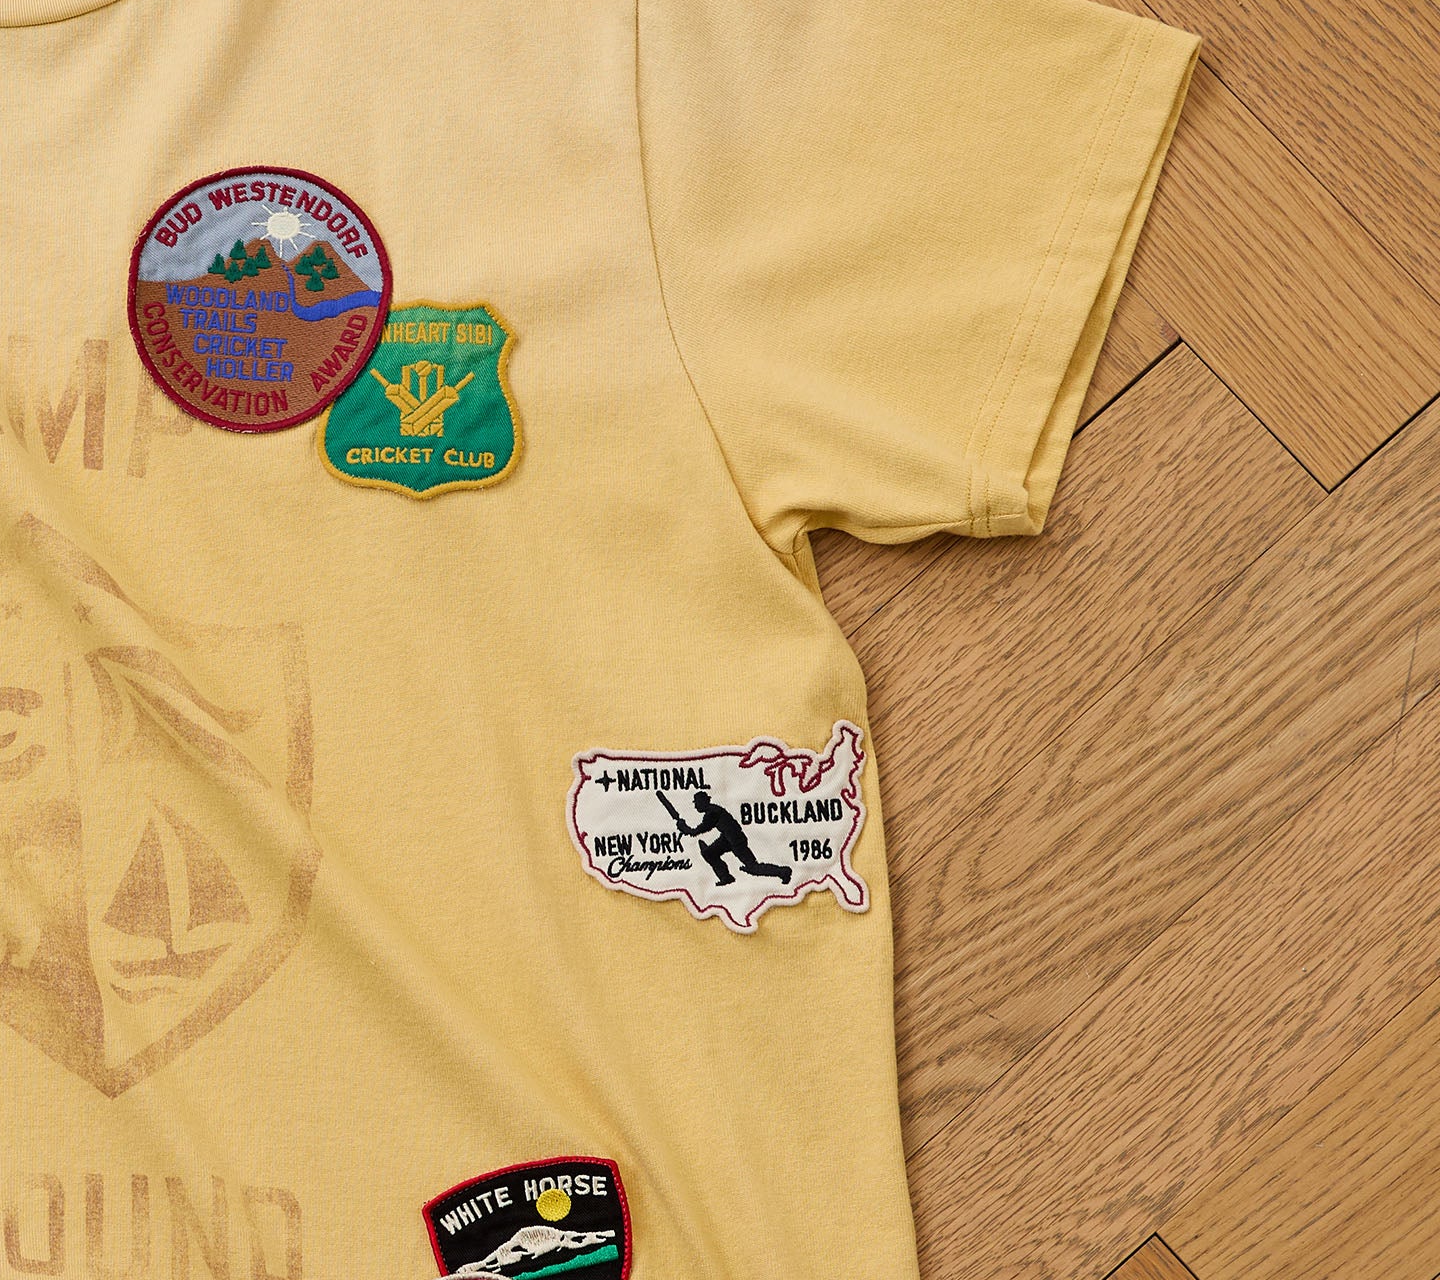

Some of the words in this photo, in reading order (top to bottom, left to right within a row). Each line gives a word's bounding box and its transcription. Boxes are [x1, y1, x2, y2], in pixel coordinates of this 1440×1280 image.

[154, 202, 203, 248] BUD
[208, 181, 369, 259] WESTENDORF
[165, 283, 291, 313] WOODLAND
[179, 308, 258, 334] TRAILS
[142, 302, 289, 416] CONSERVATION
[310, 314, 368, 394] AWARD
[193, 332, 288, 359] CRICKET
[205, 357, 294, 382] HOLLER
[346, 447, 433, 465] CRICKET
[443, 448, 496, 468] CLUB
[616, 767, 711, 791] NATIONAL
[740, 798, 843, 825] BUCKLAND
[594, 833, 633, 858] NEW
[636, 830, 685, 853] YORK
[789, 839, 833, 861] 1986
[608, 854, 693, 880] Champions
[439, 1186, 513, 1236] WHITE
